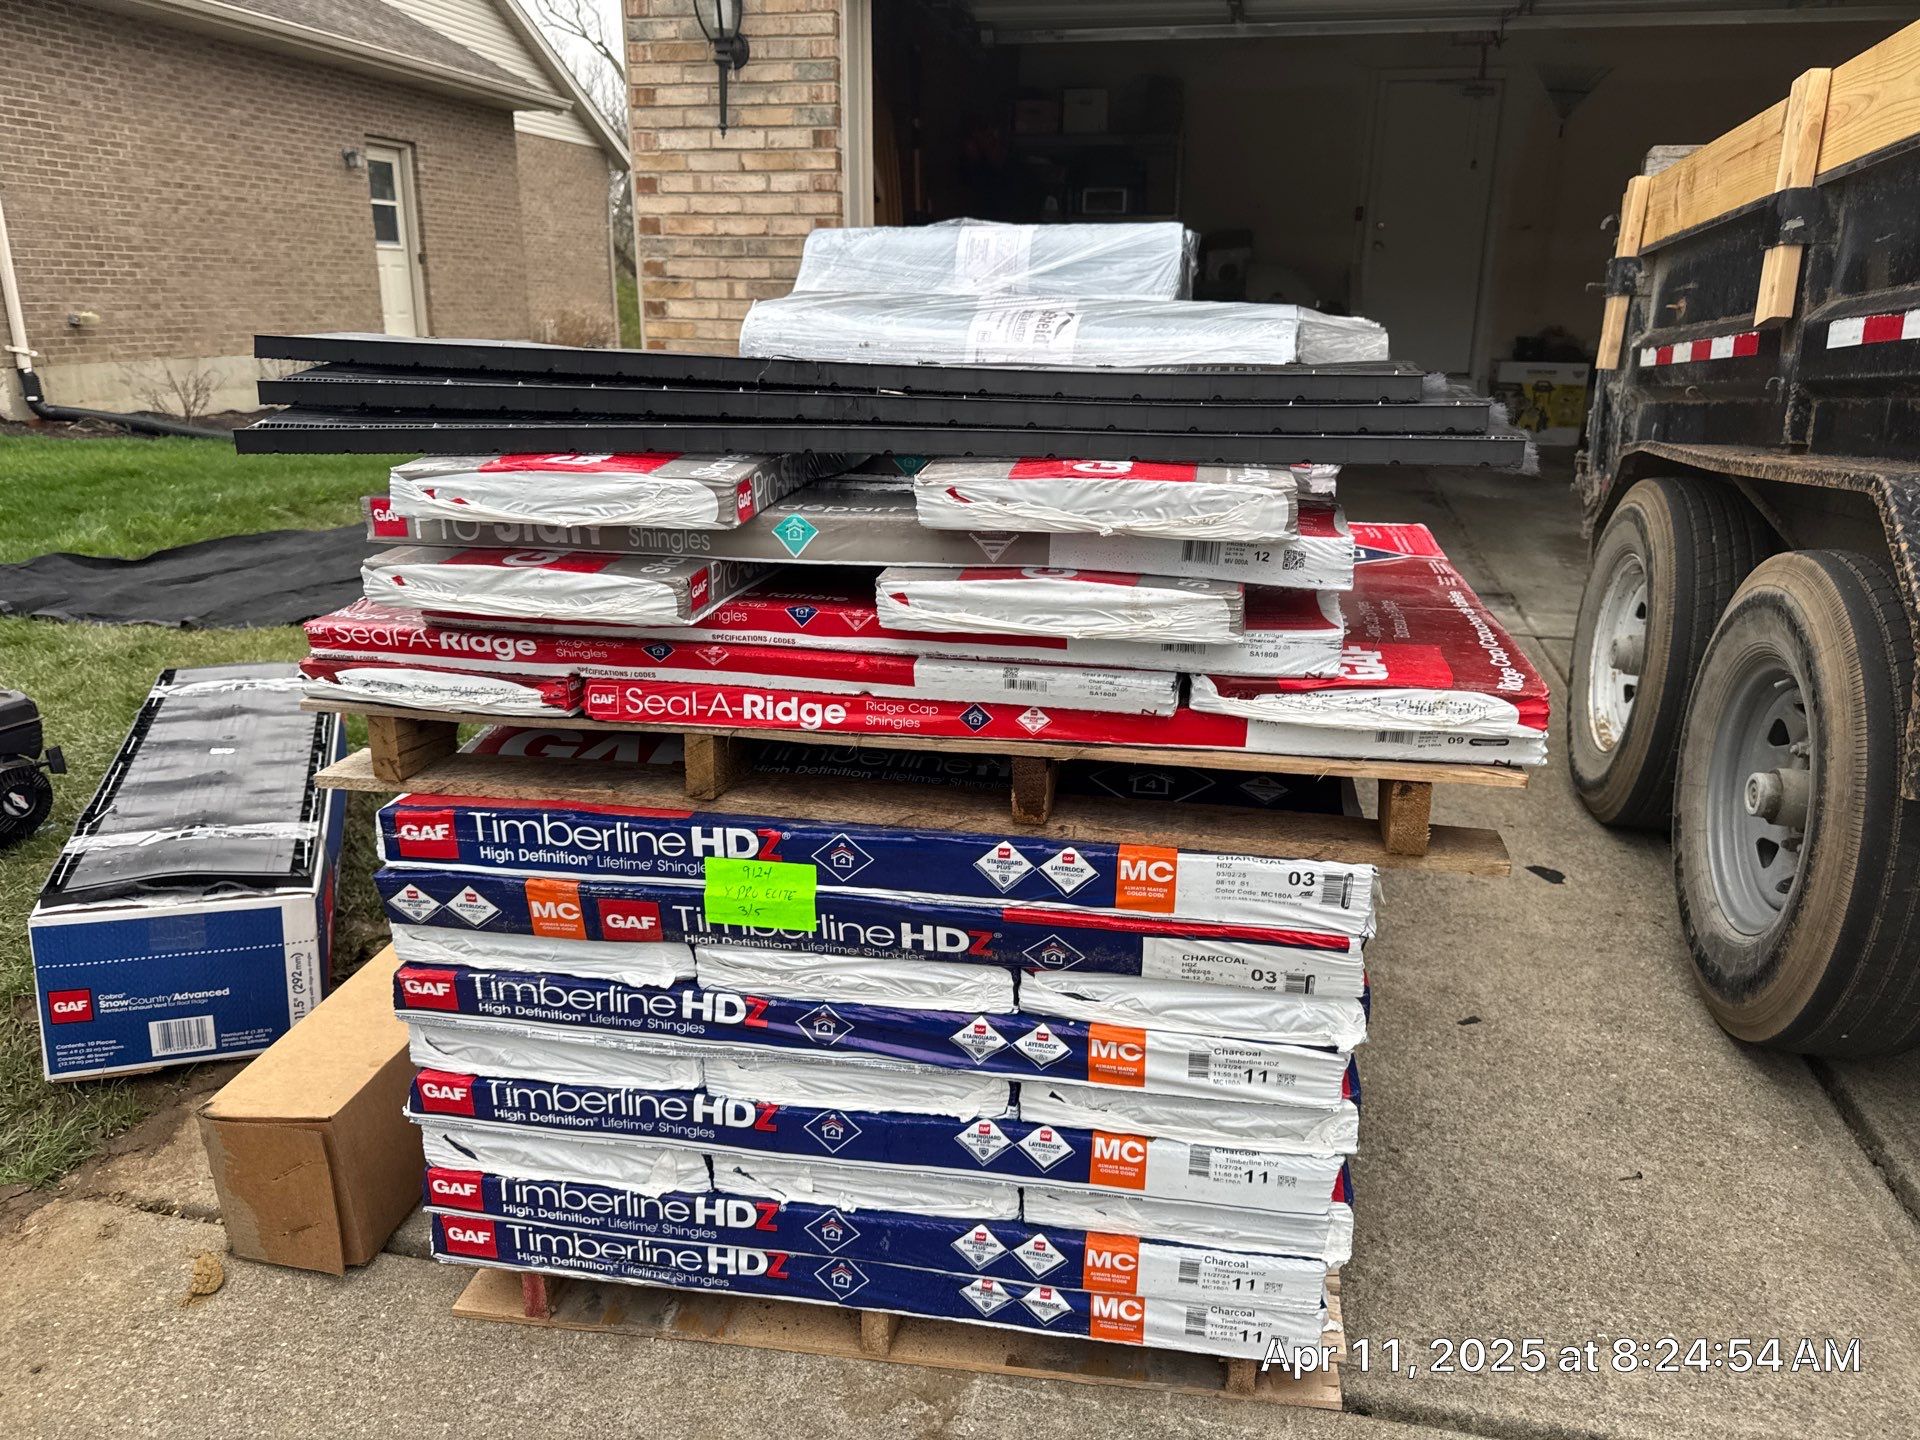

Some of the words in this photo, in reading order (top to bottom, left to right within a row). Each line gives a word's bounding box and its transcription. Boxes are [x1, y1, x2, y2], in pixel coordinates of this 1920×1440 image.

[738, 490, 752, 509] GAF
[629, 528, 710, 554] Shingles
[1254, 550, 1270, 563] 12
[692, 579, 707, 598] GAF
[335, 624, 537, 661] Seal-A-Ridge
[556, 648, 608, 659] Shingles
[591, 693, 616, 704] GAF
[625, 687, 846, 729] Seal-A-Ridge
[865, 700, 904, 716] Ridge
[907, 703, 939, 718] Cap
[865, 715, 920, 729] Shingles
[1447, 736, 1464, 745] 09
[400, 824, 449, 842] GAF
[468, 812, 686, 857] Timberline
[691, 827, 784, 862] HDZ
[480, 846, 515, 862] High
[518, 849, 588, 866] Definition
[987, 858, 1023, 866] STAINGUARD
[1051, 865, 1085, 873] LAYERLOCK
[1120, 860, 1174, 882] MC
[1288, 871, 1315, 886] 03
[1261, 891, 1292, 899] MC180A
[532, 901, 580, 920] MC
[606, 913, 657, 931] GAF
[722, 936, 792, 950] Definition
[900, 923, 994, 956] HDZ
[1182, 954, 1249, 965] CHARCOAL
[291, 970, 306, 994] (292
[1251, 969, 1277, 984] 03
[54, 1000, 88, 1013] GAF
[404, 979, 450, 996] GAF
[468, 972, 676, 1017] Timberline
[682, 995, 768, 1029] HDZ
[478, 1001, 512, 1016] High
[515, 1005, 582, 1021] Definition
[647, 1018, 705, 1035] Shingles
[962, 1034, 997, 1042] STAINGUARD
[1025, 1041, 1058, 1050] LAYERLOCK
[1091, 1040, 1143, 1061] MC
[1214, 1048, 1261, 1057] Charcoal
[1244, 1068, 1268, 1084] 11
[422, 1083, 467, 1101] GAF
[485, 1079, 688, 1121] Timberline
[494, 1108, 526, 1122] High
[528, 1111, 594, 1127] Definition
[658, 1123, 715, 1139] Shingles
[967, 1133, 1001, 1141] STAINGUARD
[1028, 1141, 1060, 1150] LAYERLOCK
[1094, 1137, 1144, 1163] MC
[1225, 1158, 1261, 1166] Timberline
[1263, 1159, 1279, 1167] HDZ
[1244, 1170, 1268, 1184] 11
[432, 1180, 477, 1197] GAF
[499, 1178, 690, 1224] Timberline
[502, 1203, 534, 1218] High
[537, 1206, 600, 1224] Definition
[662, 1222, 717, 1239] Shingles
[447, 1226, 492, 1244] GAF
[506, 1224, 702, 1272] Timberline
[1023, 1250, 1054, 1258] LAYERLOCK
[1087, 1249, 1136, 1271] MC
[1204, 1256, 1249, 1268] Charcoal
[517, 1251, 548, 1265] High
[676, 1271, 730, 1287] Shingles
[1232, 1278, 1256, 1290] 11
[1093, 1296, 1143, 1320] MC
[1210, 1305, 1255, 1317] Charcoal
[1239, 1330, 1262, 1343] 11
